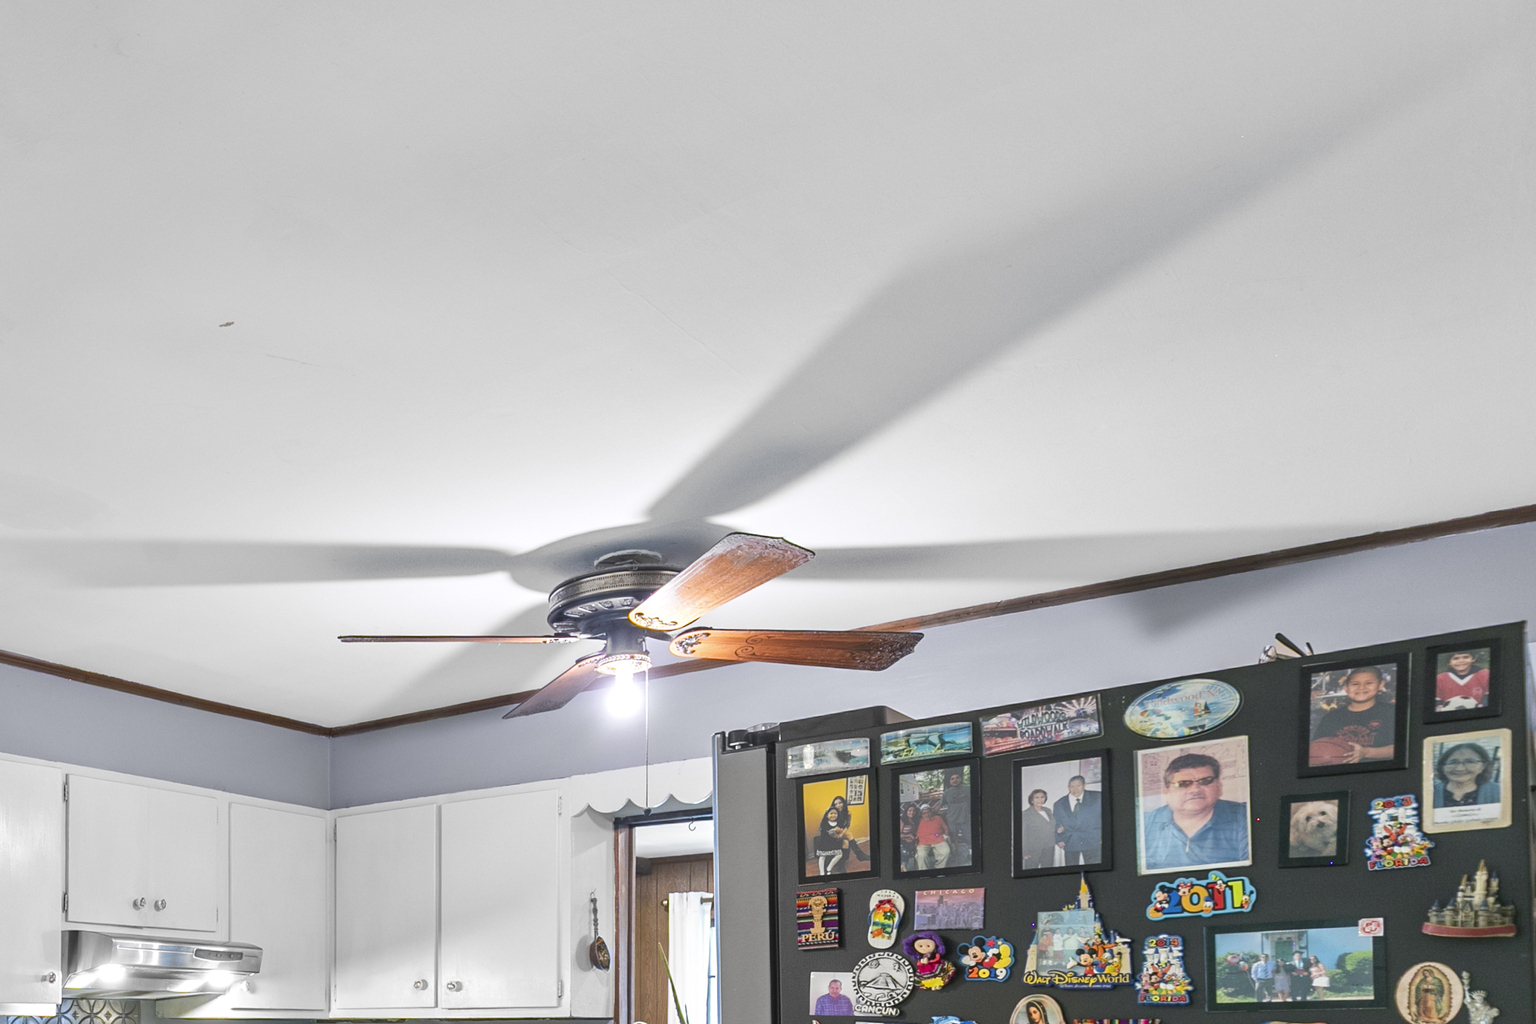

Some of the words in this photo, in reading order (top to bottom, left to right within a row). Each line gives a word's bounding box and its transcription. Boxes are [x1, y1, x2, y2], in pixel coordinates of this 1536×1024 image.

[902, 743, 946, 758] Florida
[1369, 856, 1429, 869] FLORIDA
[923, 888, 975, 896] CHICAGO
[1158, 880, 1246, 914] 2011
[802, 930, 835, 942] PERÚ
[1148, 938, 1179, 948] 2014
[968, 967, 1007, 979] 2019
[1097, 973, 1130, 984] World
[1139, 995, 1187, 1003] FLORIDA
[855, 1004, 900, 1016] CANCUN
